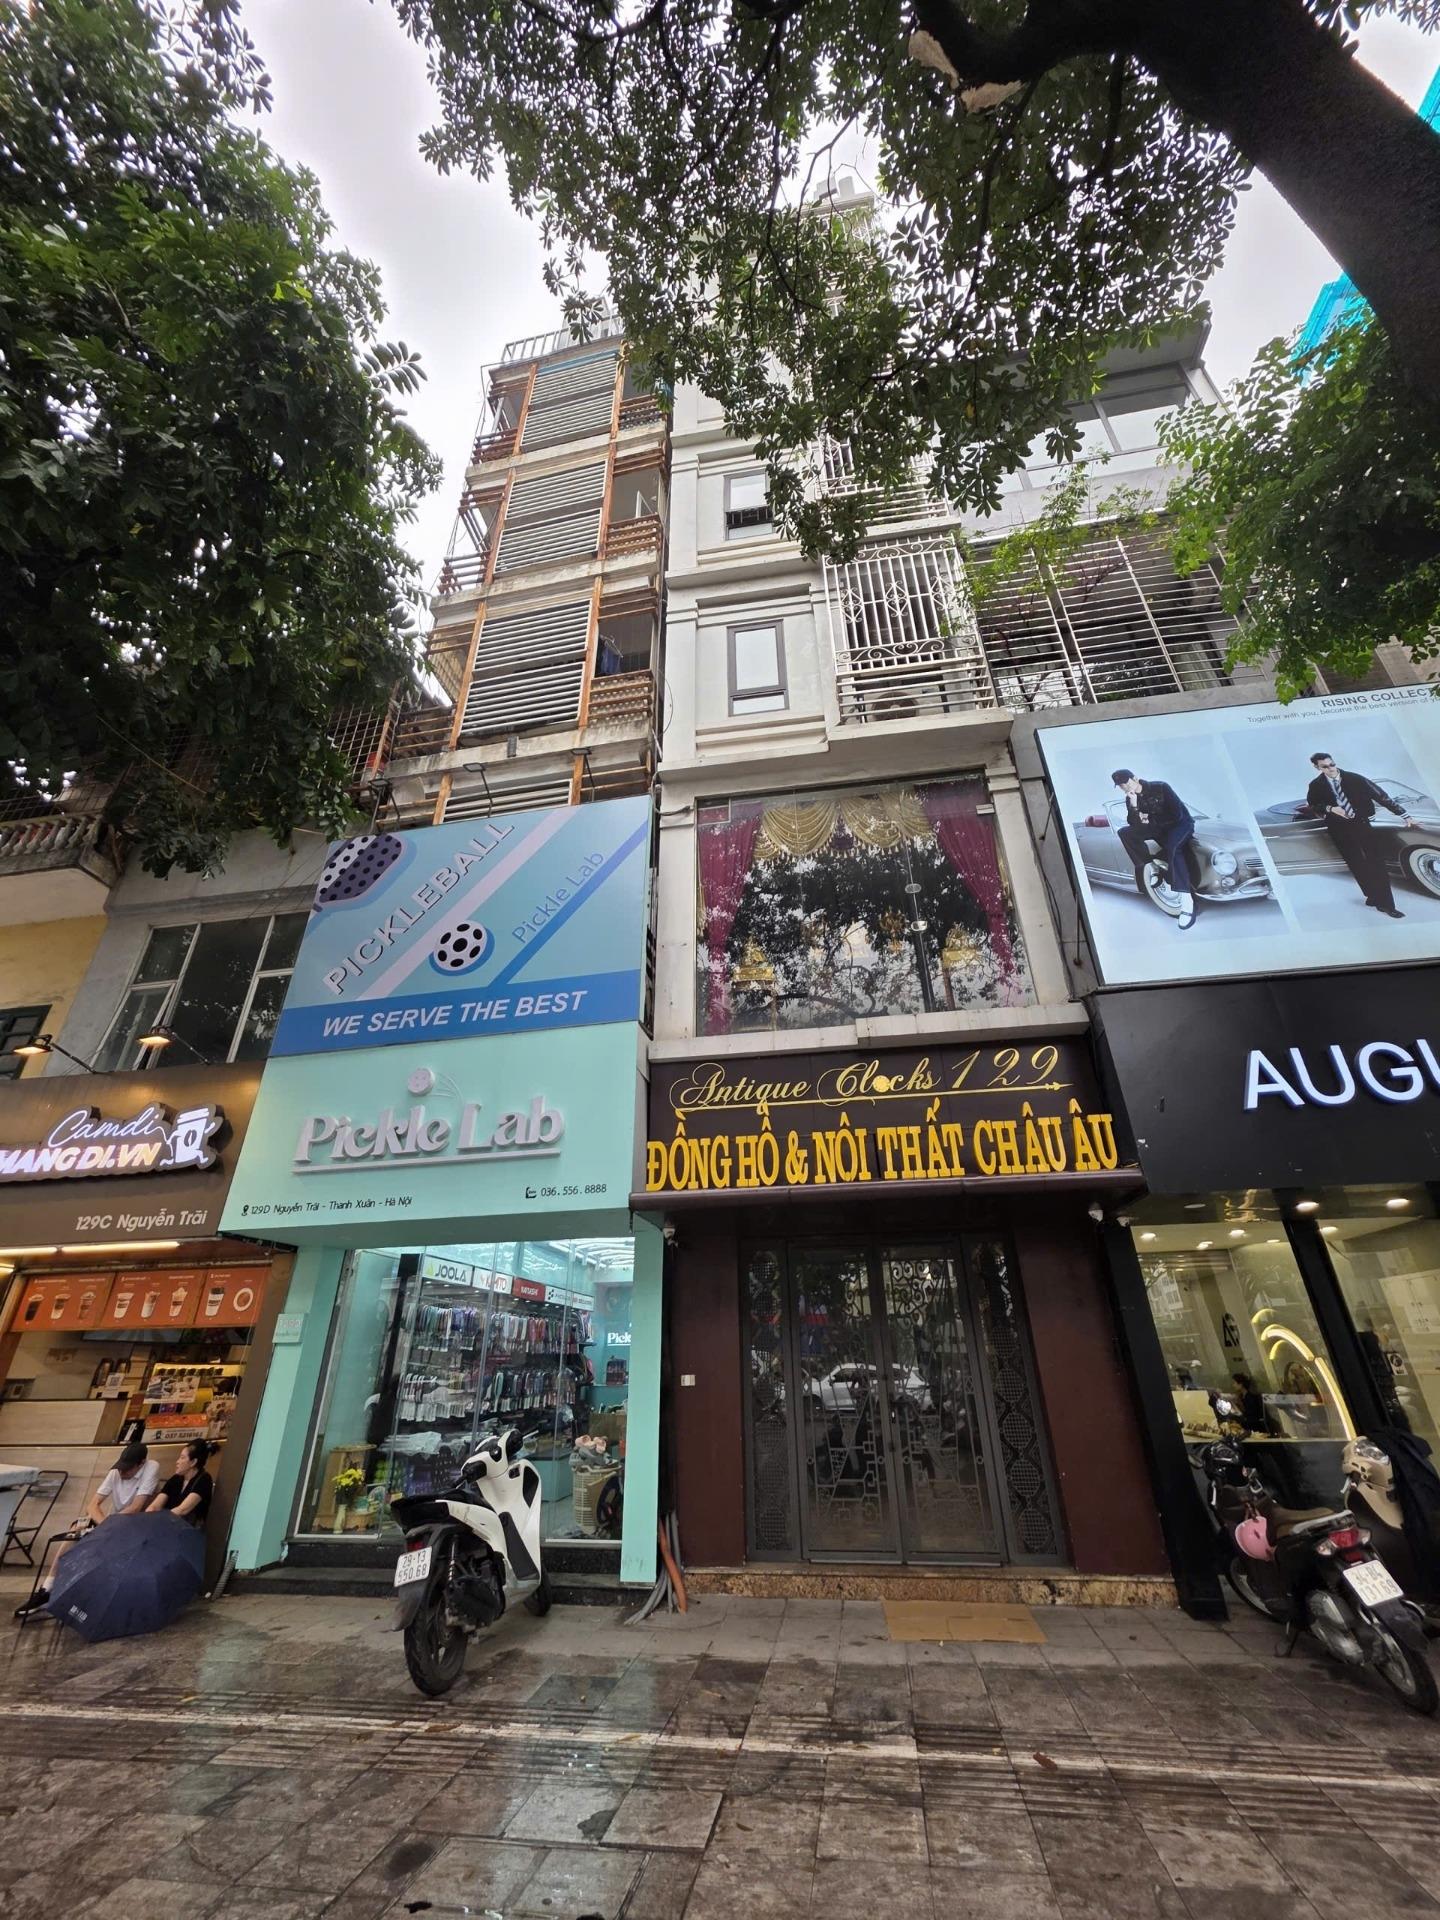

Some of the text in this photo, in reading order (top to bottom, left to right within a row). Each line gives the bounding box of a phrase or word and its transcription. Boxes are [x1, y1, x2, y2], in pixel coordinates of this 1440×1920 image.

[1247, 713, 1283, 724] Together
[1284, 710, 1299, 720] with
[1320, 705, 1352, 715] become
[1354, 703, 1367, 712] the
[1369, 701, 1387, 710] best
[1322, 695, 1368, 708] RISING
[322, 822, 515, 996] PICKLEBALL
[512, 850, 604, 943] Pickle Lab
[322, 990, 588, 1037] WE SERVE THE BEST
[669, 1062, 812, 1114] Antique
[950, 1045, 1060, 1090] 129
[48, 1106, 161, 1148] Camdi
[292, 1095, 566, 1164] Pickle Lab
[645, 1108, 733, 1192] ĐỒNG
[785, 1130, 808, 1185] &
[877, 1096, 966, 1181] THẤT
[973, 1101, 1067, 1175] CHÂU
[1069, 1098, 1118, 1171] ÂU
[75, 1208, 208, 1232] 129C Nguyễn Trãi
[250, 1204, 271, 1215] 129D
[329, 1199, 352, 1210] Thanh
[384, 1197, 396, 1207] Hà
[434, 1263, 467, 1283] JOOLA
